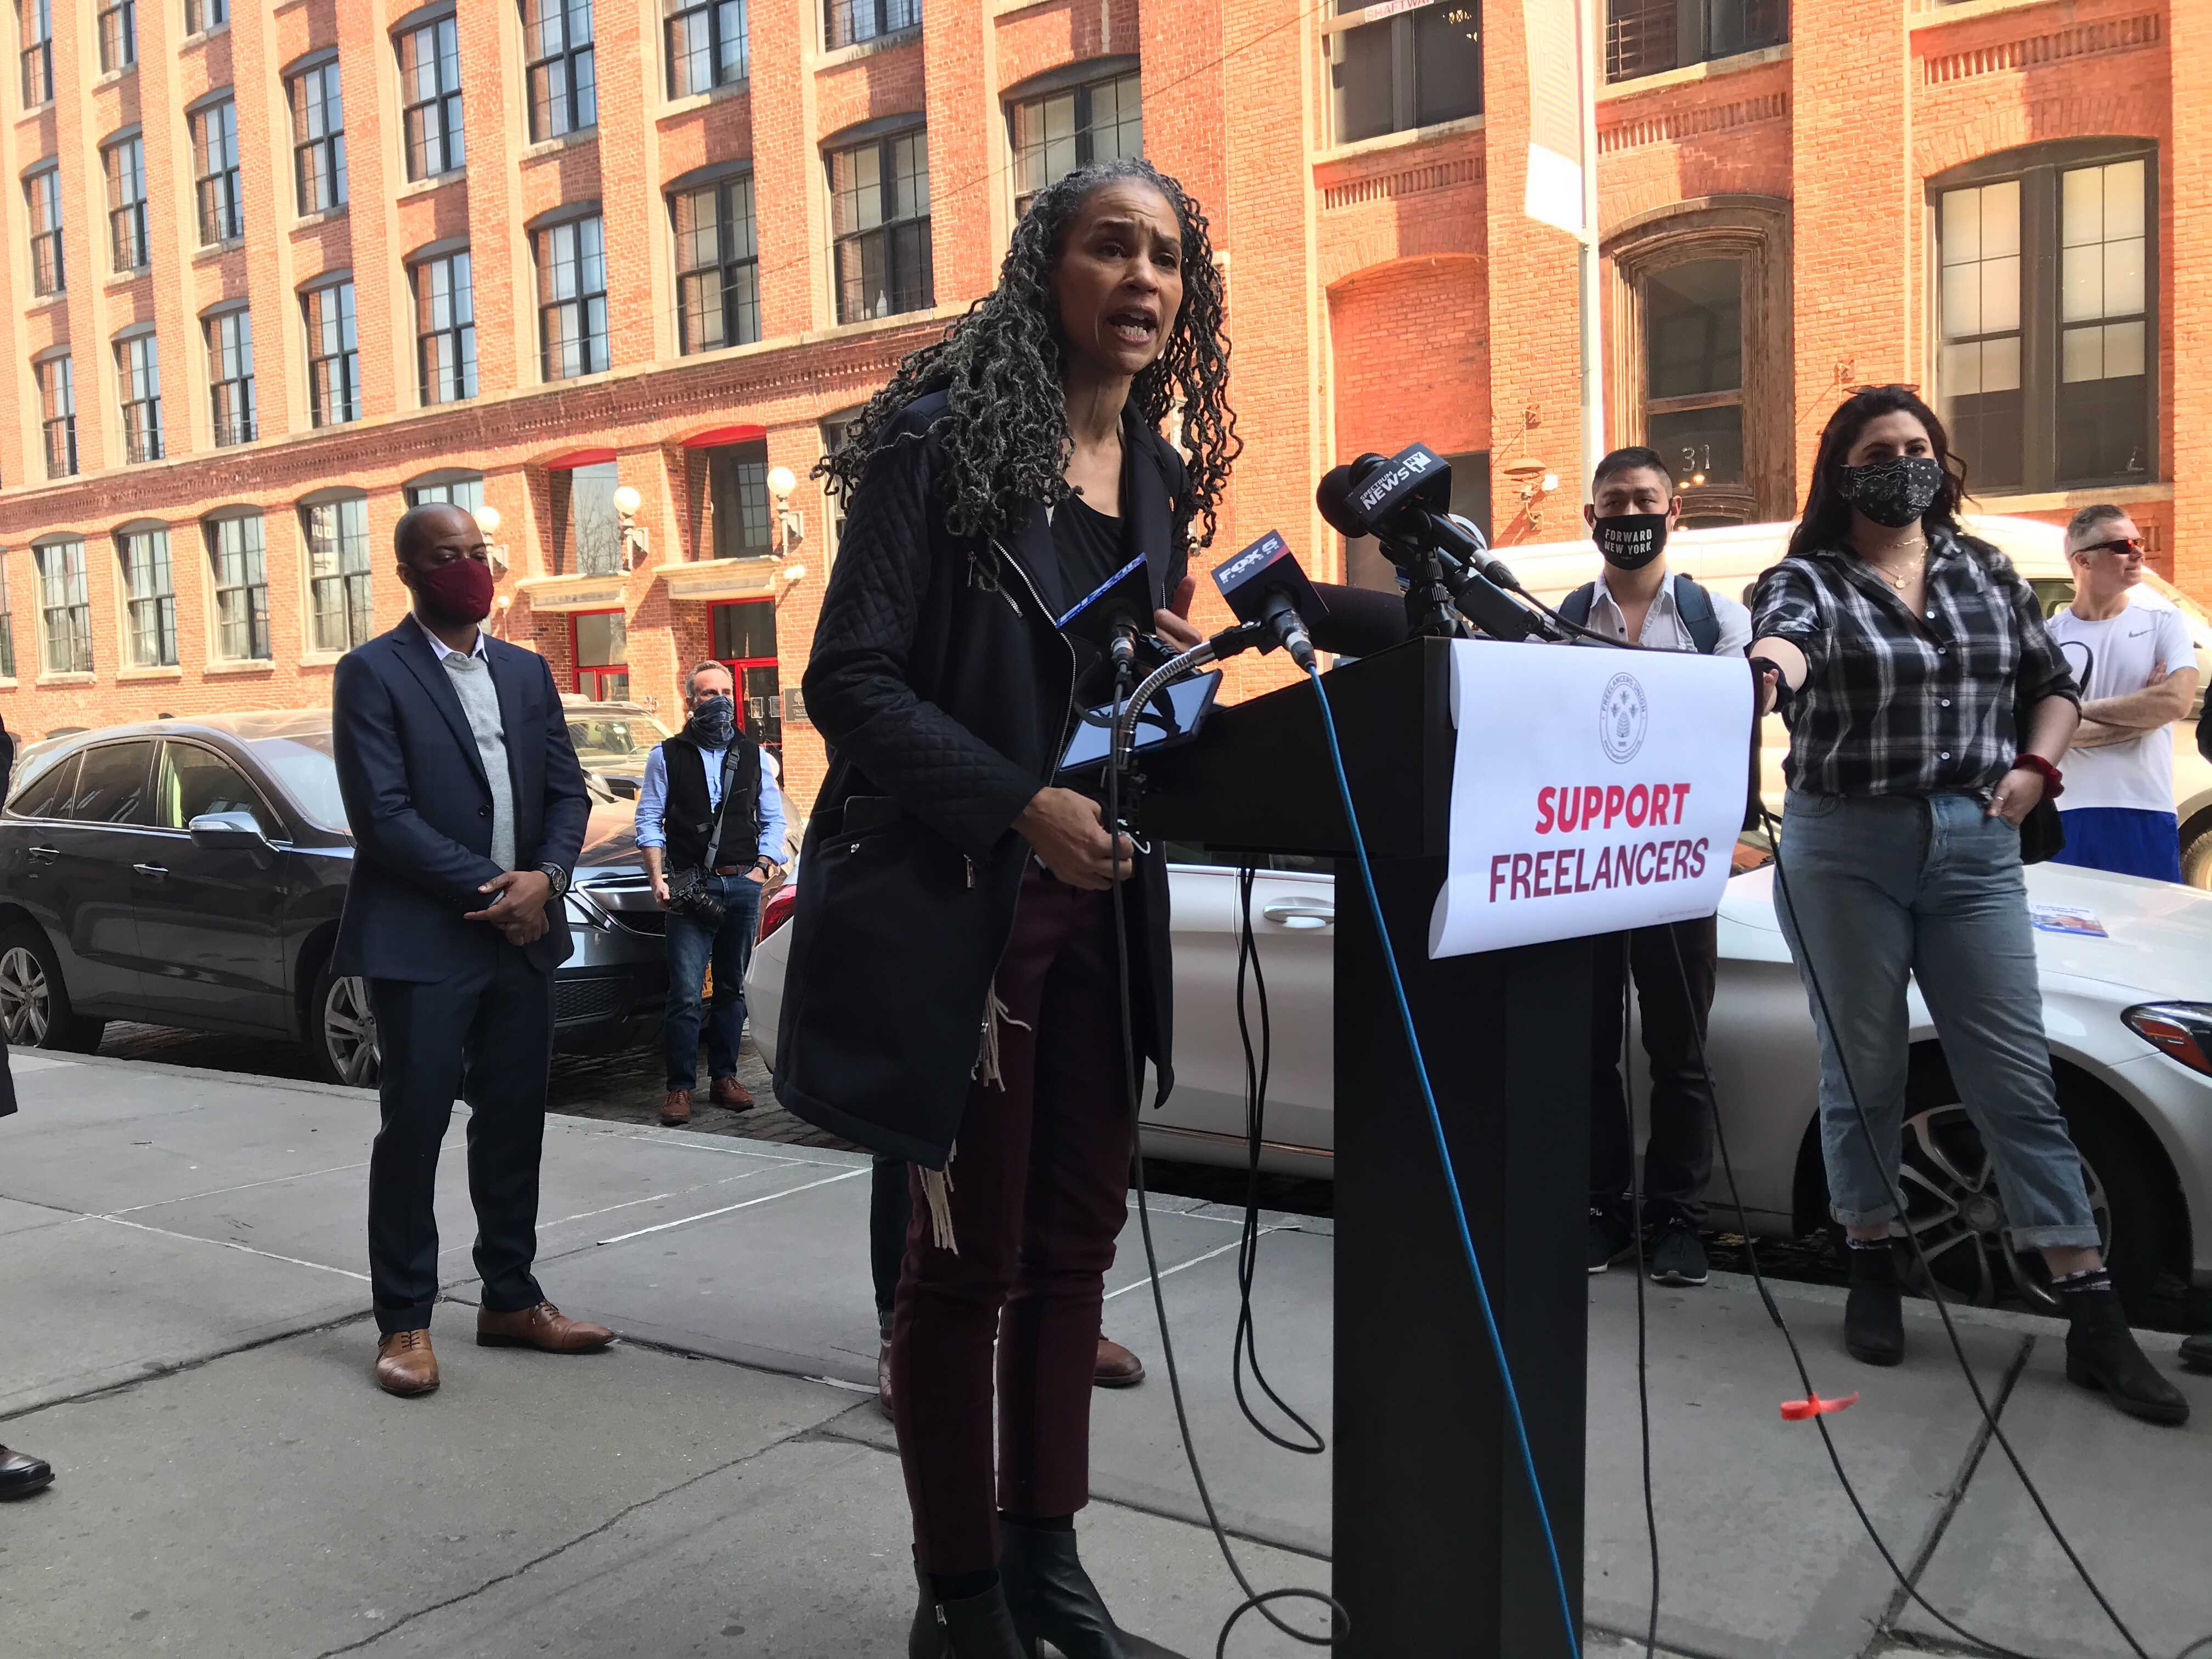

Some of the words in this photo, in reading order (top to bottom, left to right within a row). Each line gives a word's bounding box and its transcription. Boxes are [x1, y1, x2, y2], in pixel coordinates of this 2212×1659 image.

[1407, 454, 1421, 465] NY
[1681, 444, 1710, 472] 31
[1360, 471, 1393, 501] SPECTRUM
[1363, 467, 1410, 511] NEWS
[1605, 528, 1652, 543] FORWARD
[1605, 541, 1624, 554] NEW
[1628, 541, 1651, 555] YORK
[1219, 549, 1262, 582] FOX
[1535, 783, 1691, 834] SUPPORT
[1489, 837, 1709, 903] FREELANCERS
